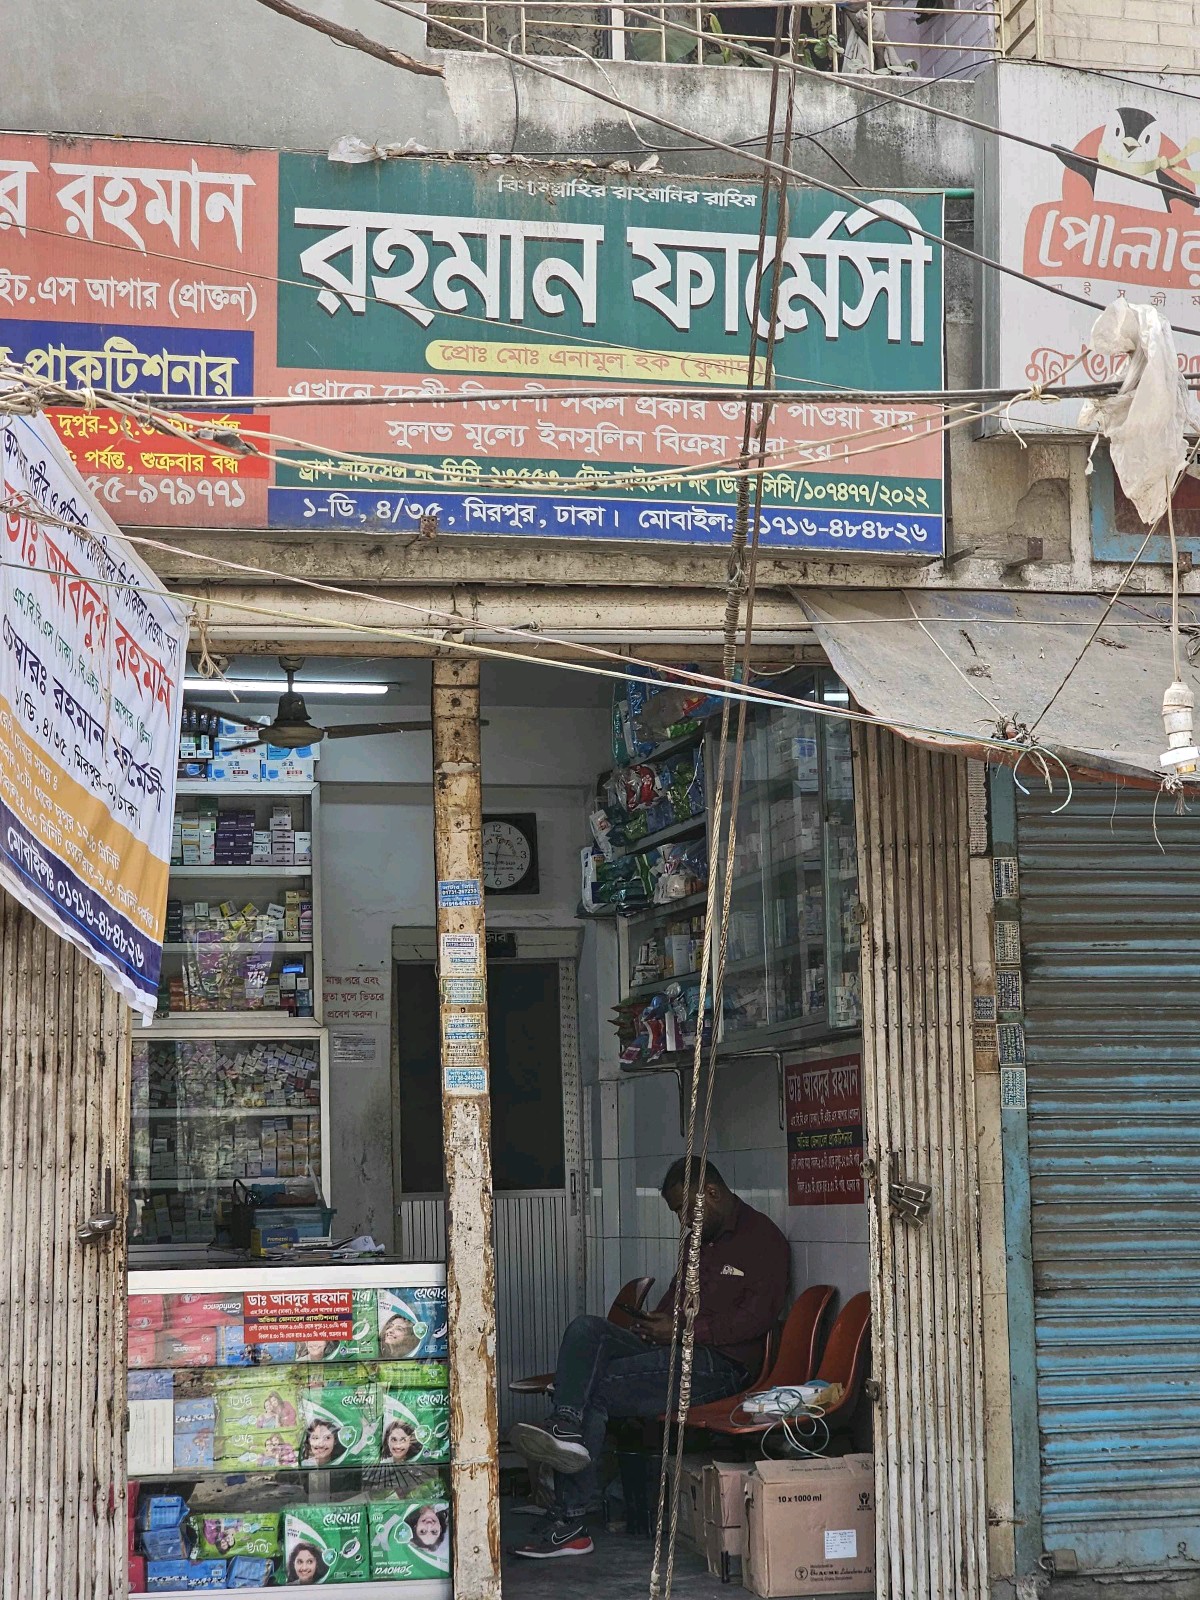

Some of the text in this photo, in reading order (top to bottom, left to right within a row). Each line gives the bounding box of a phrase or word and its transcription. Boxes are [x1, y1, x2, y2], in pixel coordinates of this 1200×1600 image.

[50, 158, 256, 257] রহমান
[612, 184, 698, 206] রাহমানির
[703, 187, 757, 208] রাহিম
[294, 199, 933, 344] রহমান ফার্মেসী
[84, 276, 161, 309] আপার
[168, 278, 258, 322] (প্রাক্তন)
[22, 336, 239, 397] প্রাকটিশনার
[440, 344, 487, 363] প্রোঃ
[496, 345, 540, 366] মোঃ
[549, 349, 626, 372] এনামুল
[633, 354, 670, 372] হক
[634, 395, 709, 421] প্রকার
[787, 403, 863, 430] পাওয়া
[385, 420, 455, 449] সুলভ
[461, 423, 529, 453] মূল্যে
[536, 418, 646, 456] ইনসুলিন
[652, 424, 729, 457] বিক্রয়
[141, 450, 207, 473] শুক্রবার
[211, 454, 239, 474] বন্ধ
[462, 497, 547, 529] মিরপুর,
[639, 506, 735, 533] মোবাইল:
[115, 617, 175, 725] রহমান
[52, 674, 106, 757] রহমান
[7, 826, 145, 968] মোবাইলঃ ০১৭১৬-৪৮৪৮২৬
[831, 1061, 859, 1101] রহমান
[202, 1302, 242, 1311] Confidence
[247, 1291, 350, 1308] ডাঃ আবদুর রহমান
[778, 1495, 787, 1503] 10
[794, 1494, 811, 1503] 1000
[812, 1493, 822, 1502] ml
